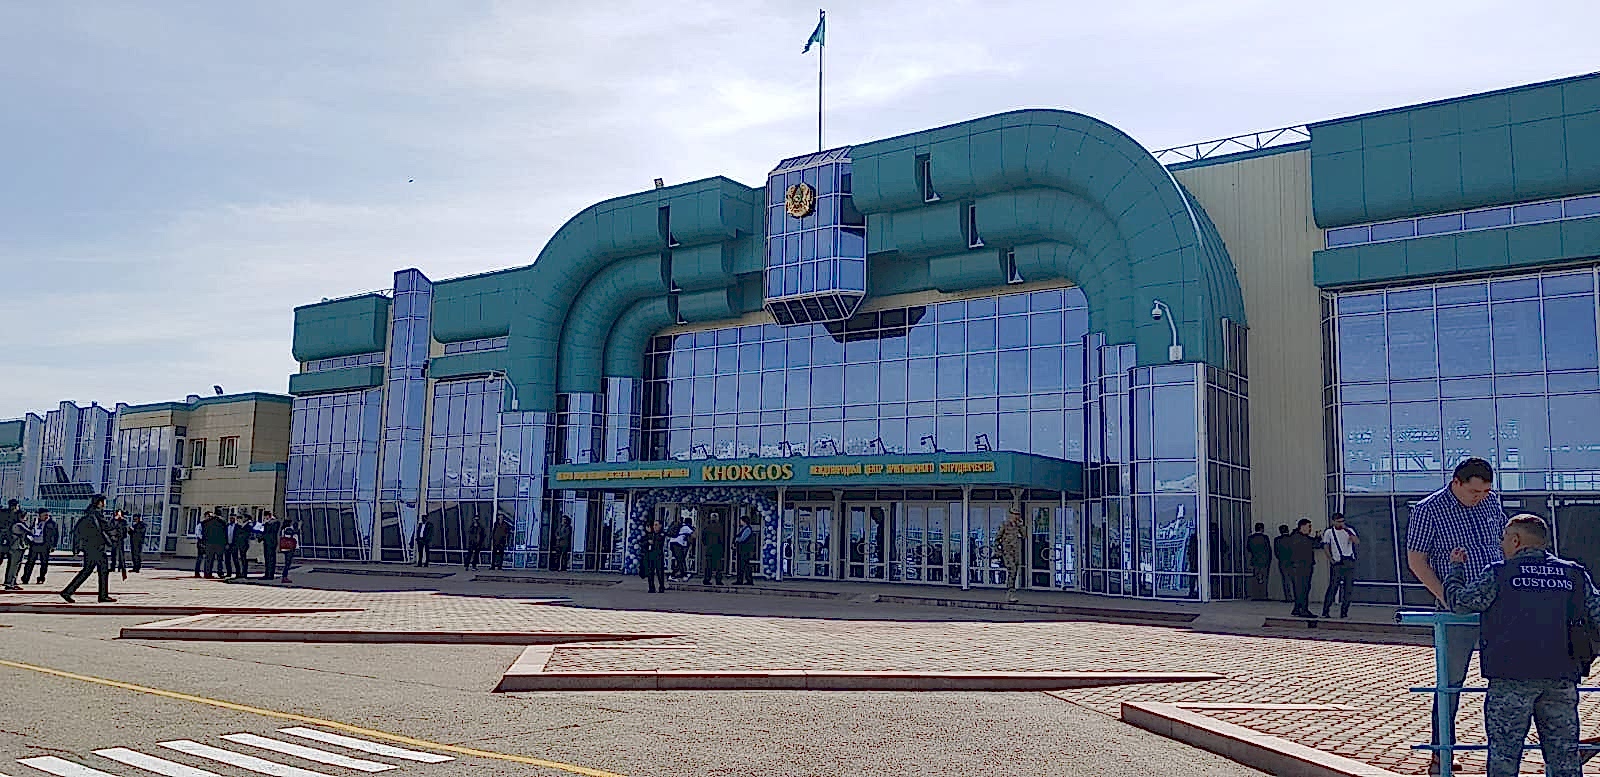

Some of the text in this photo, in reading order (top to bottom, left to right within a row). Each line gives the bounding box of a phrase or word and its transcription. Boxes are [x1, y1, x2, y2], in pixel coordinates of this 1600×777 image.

[702, 464, 793, 481] KHORGOS
[887, 463, 934, 474] ПРИГРЧНОГО
[1520, 566, 1564, 576] КЕДЕН
[1512, 577, 1573, 590] CUSTOMS
